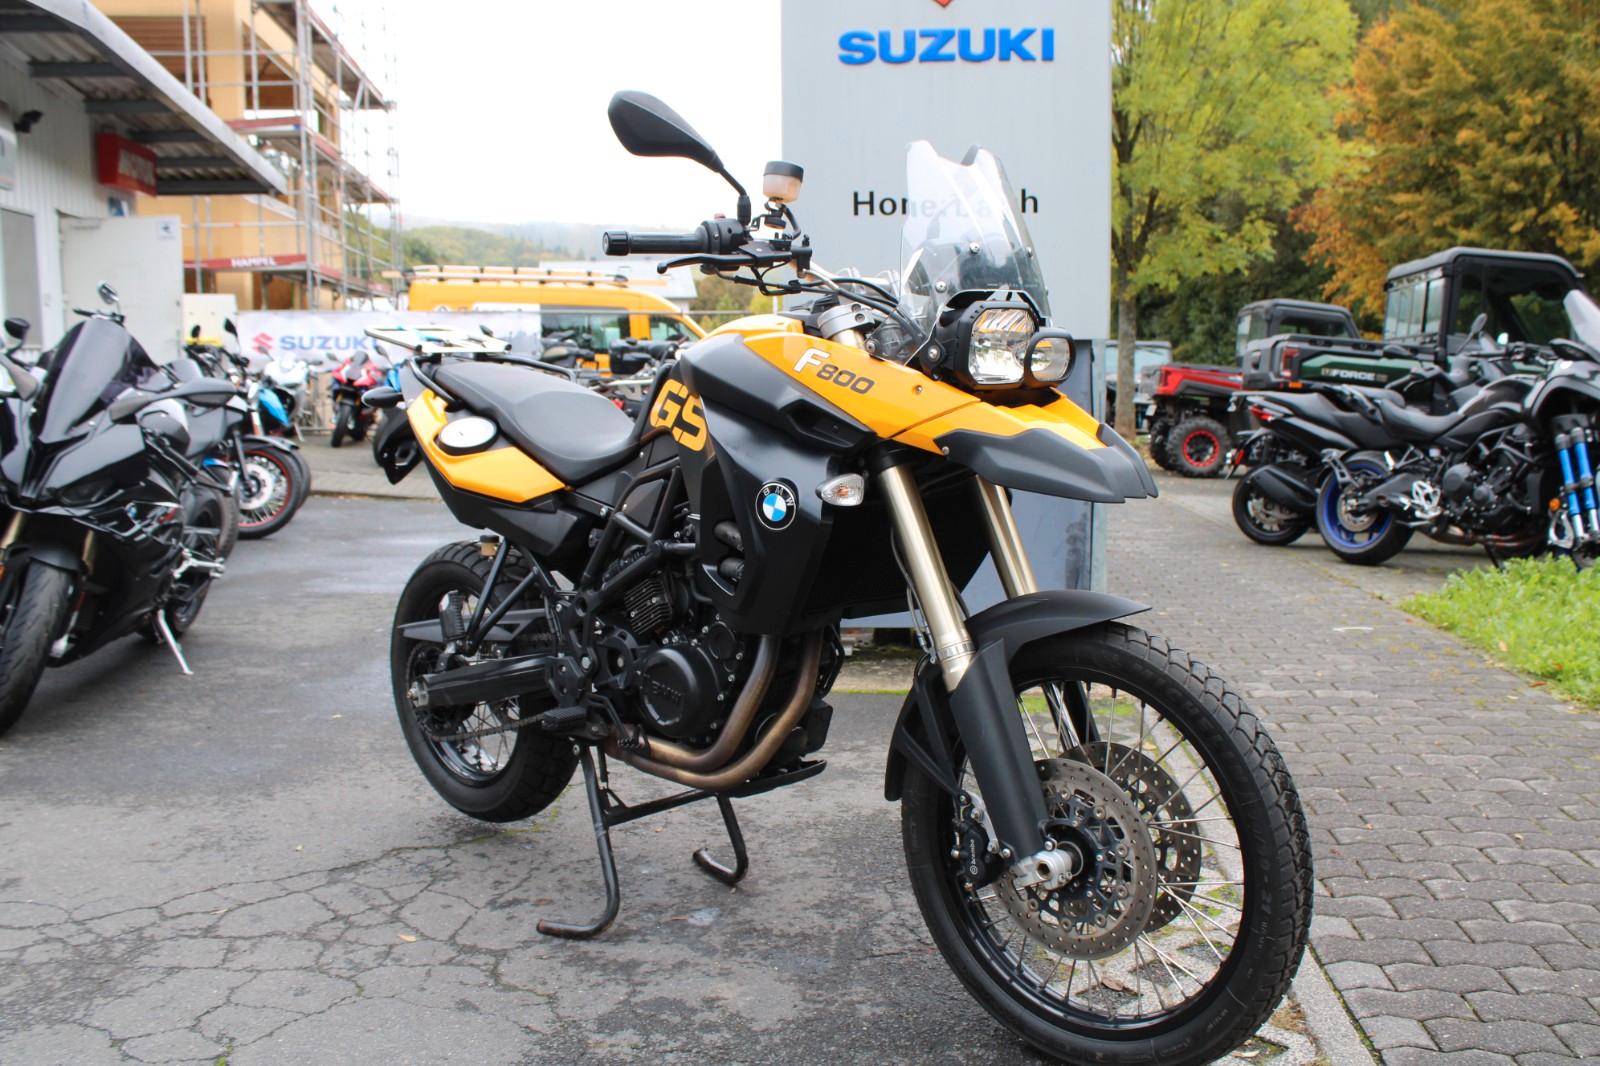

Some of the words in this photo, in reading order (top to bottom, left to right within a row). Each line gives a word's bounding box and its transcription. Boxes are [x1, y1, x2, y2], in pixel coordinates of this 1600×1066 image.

[838, 28, 1055, 65] SUZUKI
[650, 379, 708, 451] GS
[763, 486, 795, 507] BMW
